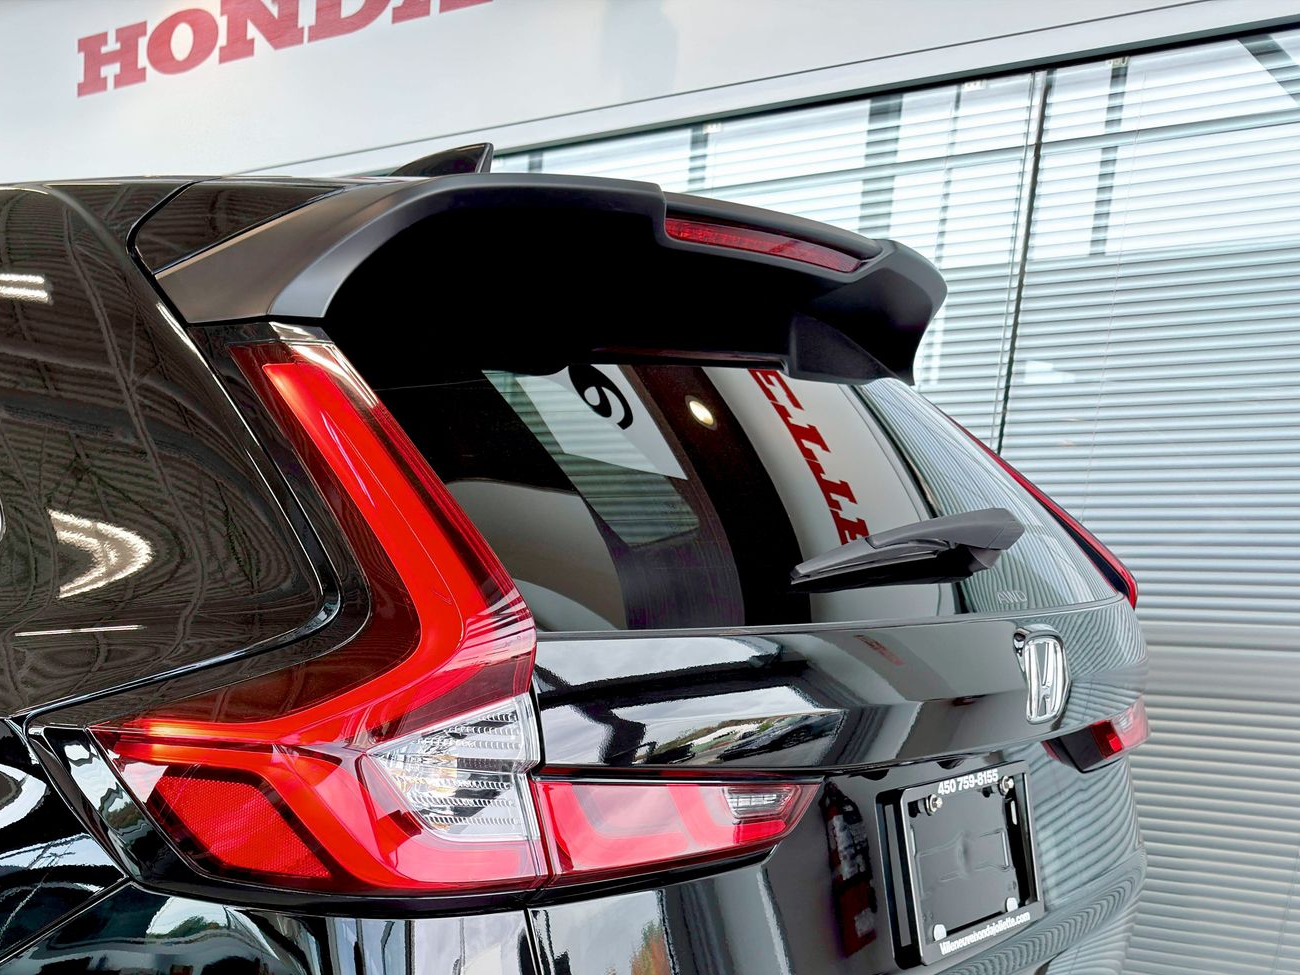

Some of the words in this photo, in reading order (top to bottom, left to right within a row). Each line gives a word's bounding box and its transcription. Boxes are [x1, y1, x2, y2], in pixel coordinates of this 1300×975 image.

[997, 590, 1027, 603] AWD
[937, 778, 957, 795] 450
[957, 768, 999, 791] 759-8155
